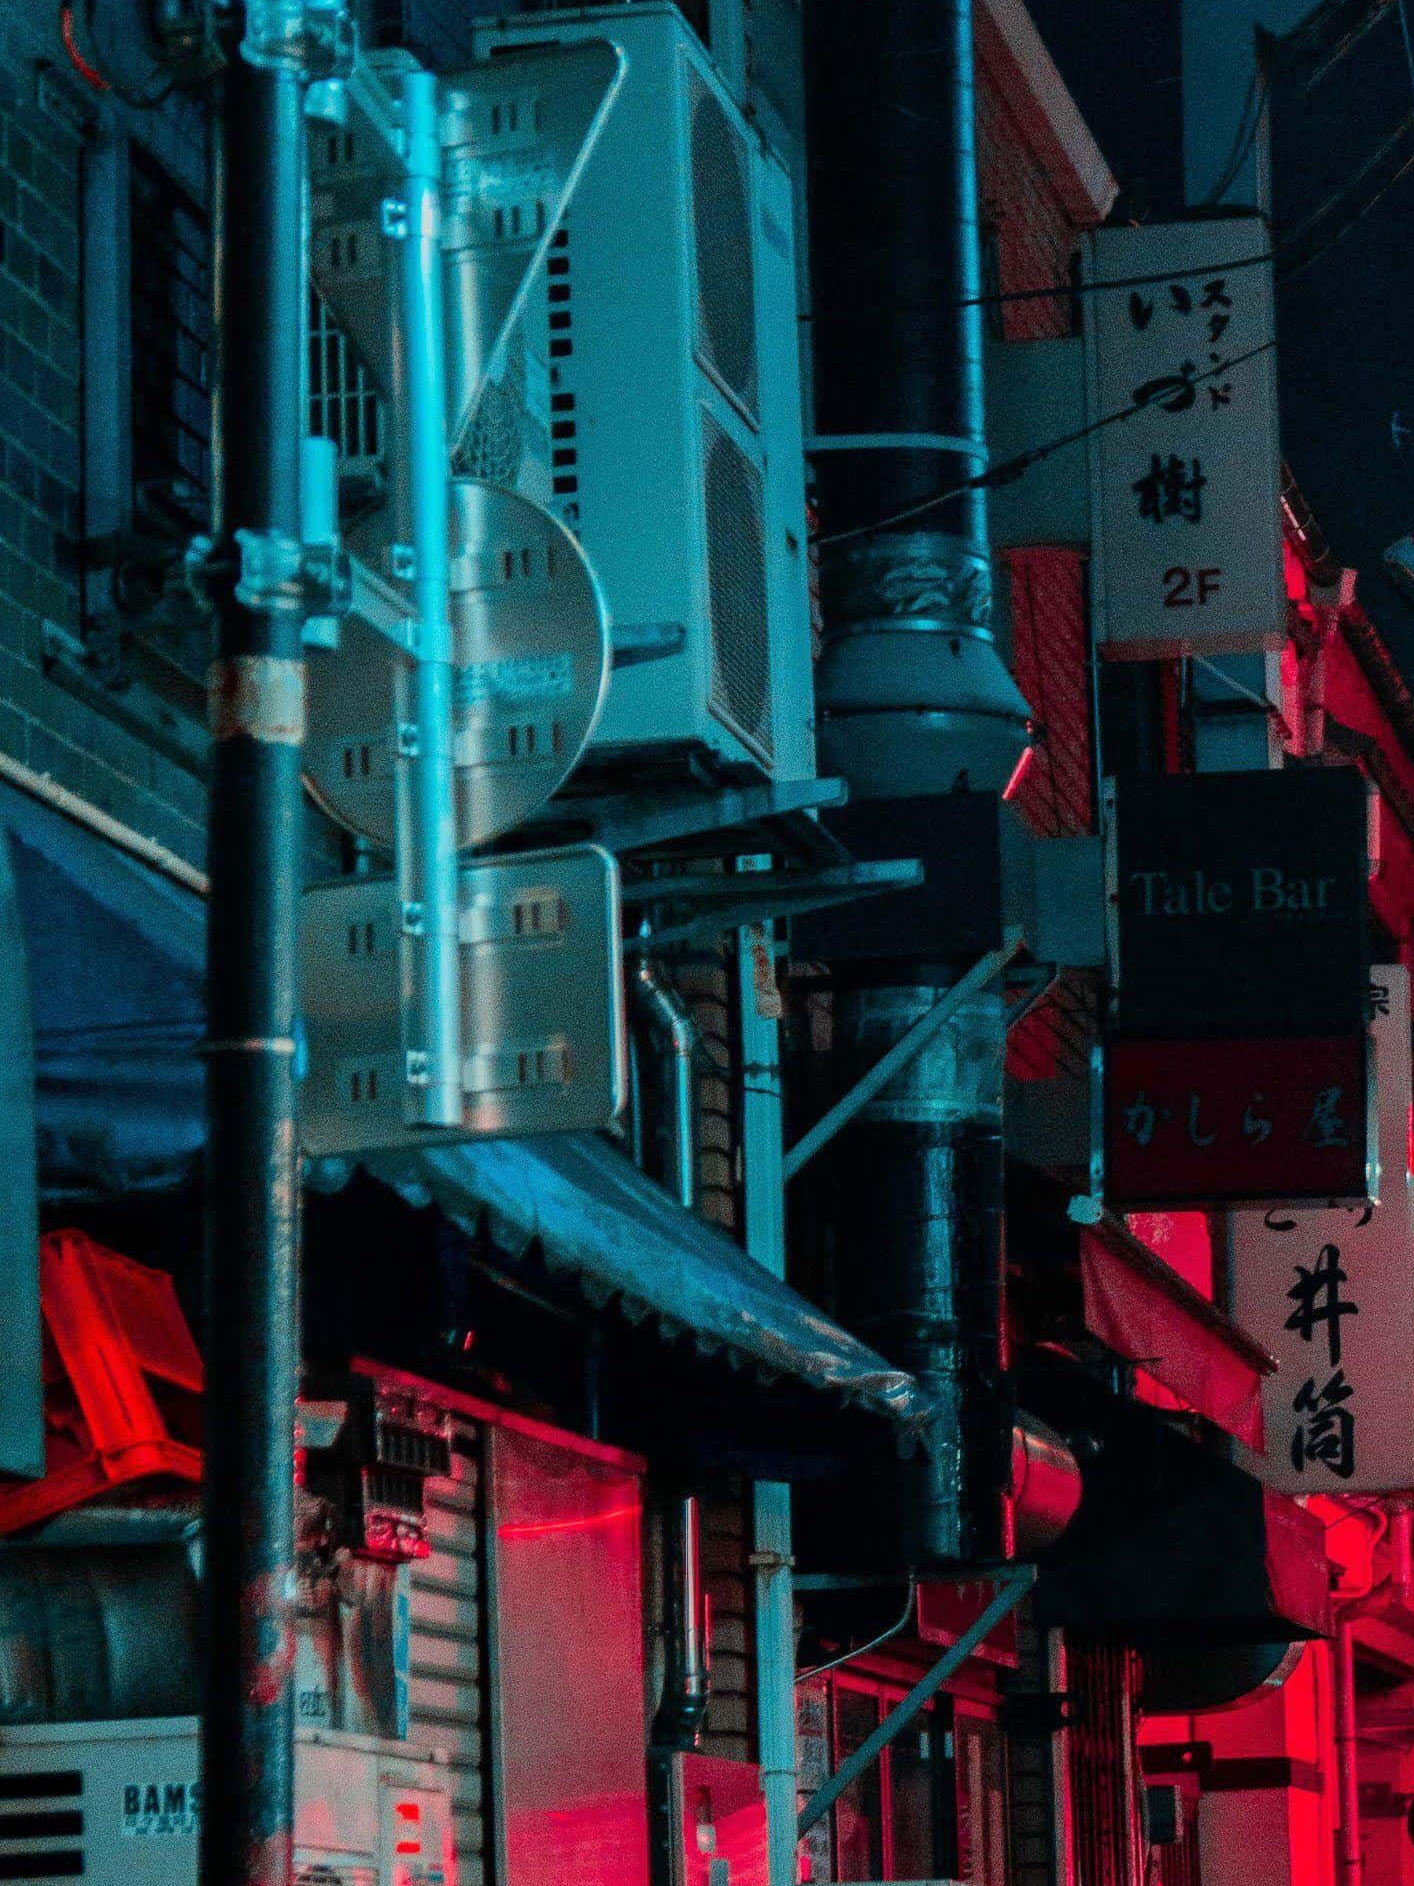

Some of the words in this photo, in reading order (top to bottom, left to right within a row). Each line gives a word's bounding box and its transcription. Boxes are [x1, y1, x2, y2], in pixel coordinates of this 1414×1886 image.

[1163, 567, 1222, 608] 2F
[1130, 871, 1233, 915] Tale
[1251, 867, 1336, 912] Bar
[1121, 1085, 1349, 1149] かしら屋
[1285, 1244, 1359, 1480] 井筒
